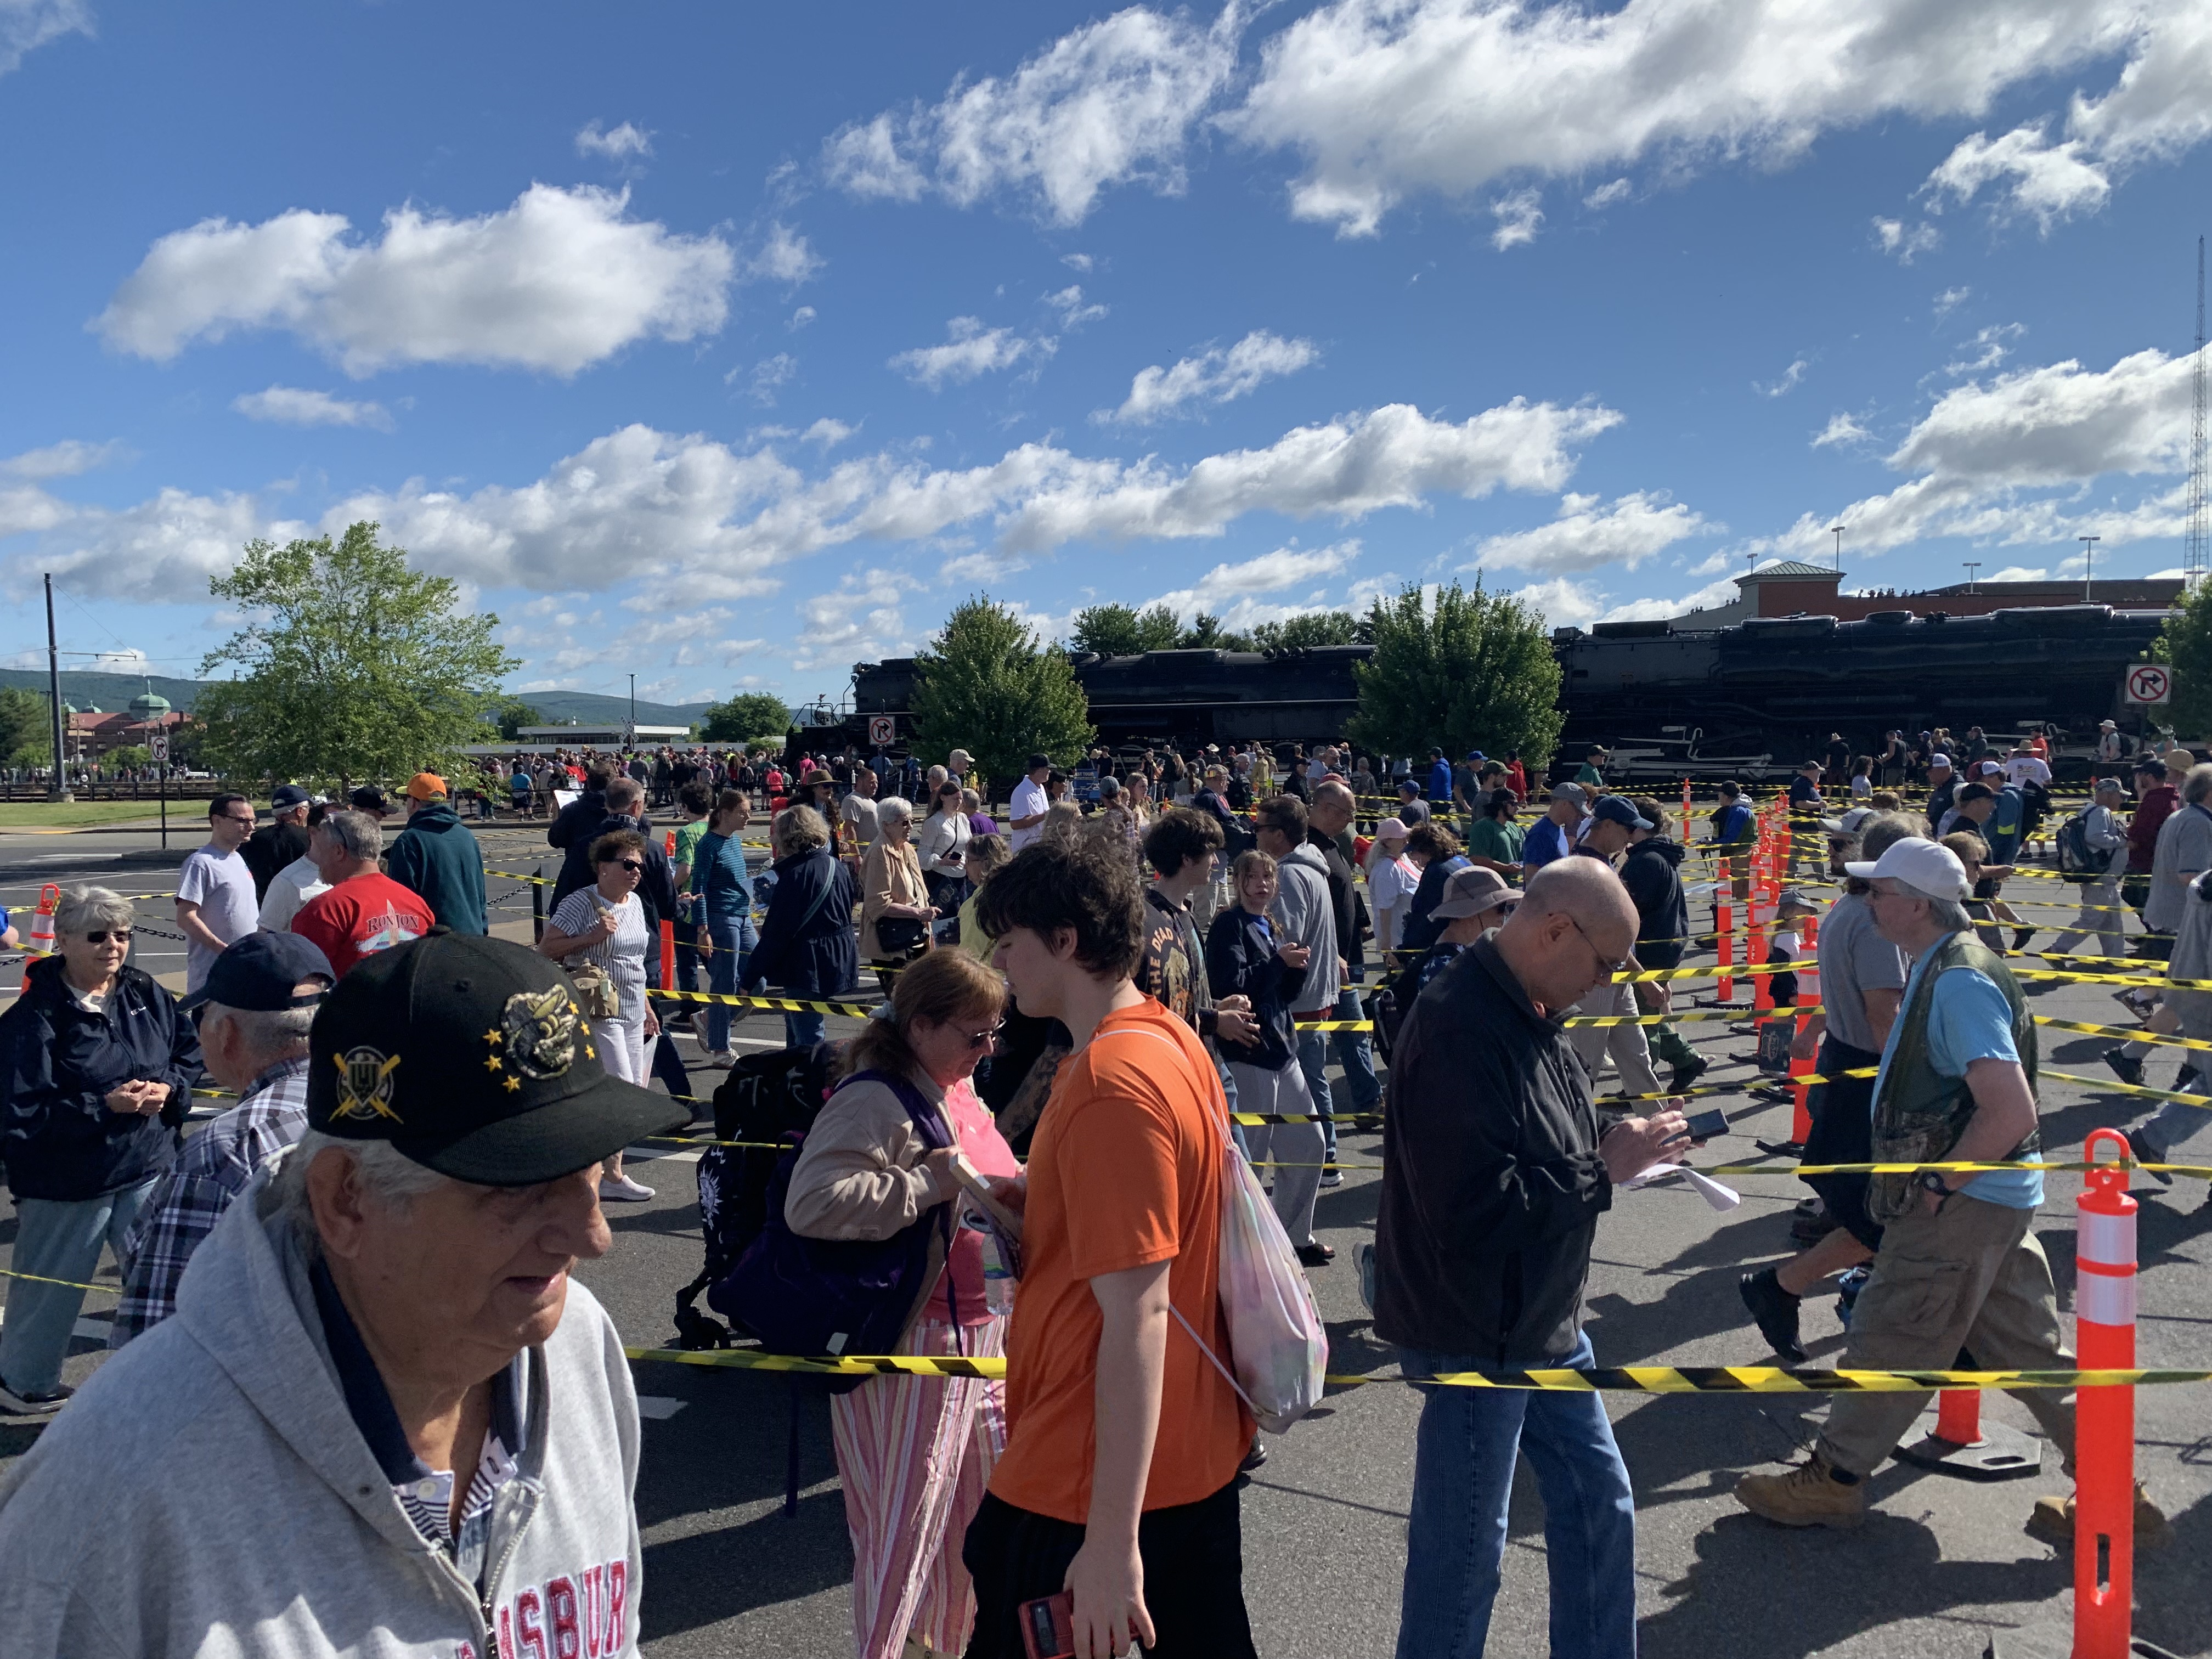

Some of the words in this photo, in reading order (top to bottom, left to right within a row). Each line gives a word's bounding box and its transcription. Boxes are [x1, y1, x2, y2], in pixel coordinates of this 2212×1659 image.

[366, 915, 393, 933] RON
[394, 913, 419, 929] JON
[1152, 927, 1173, 953] DEAD
